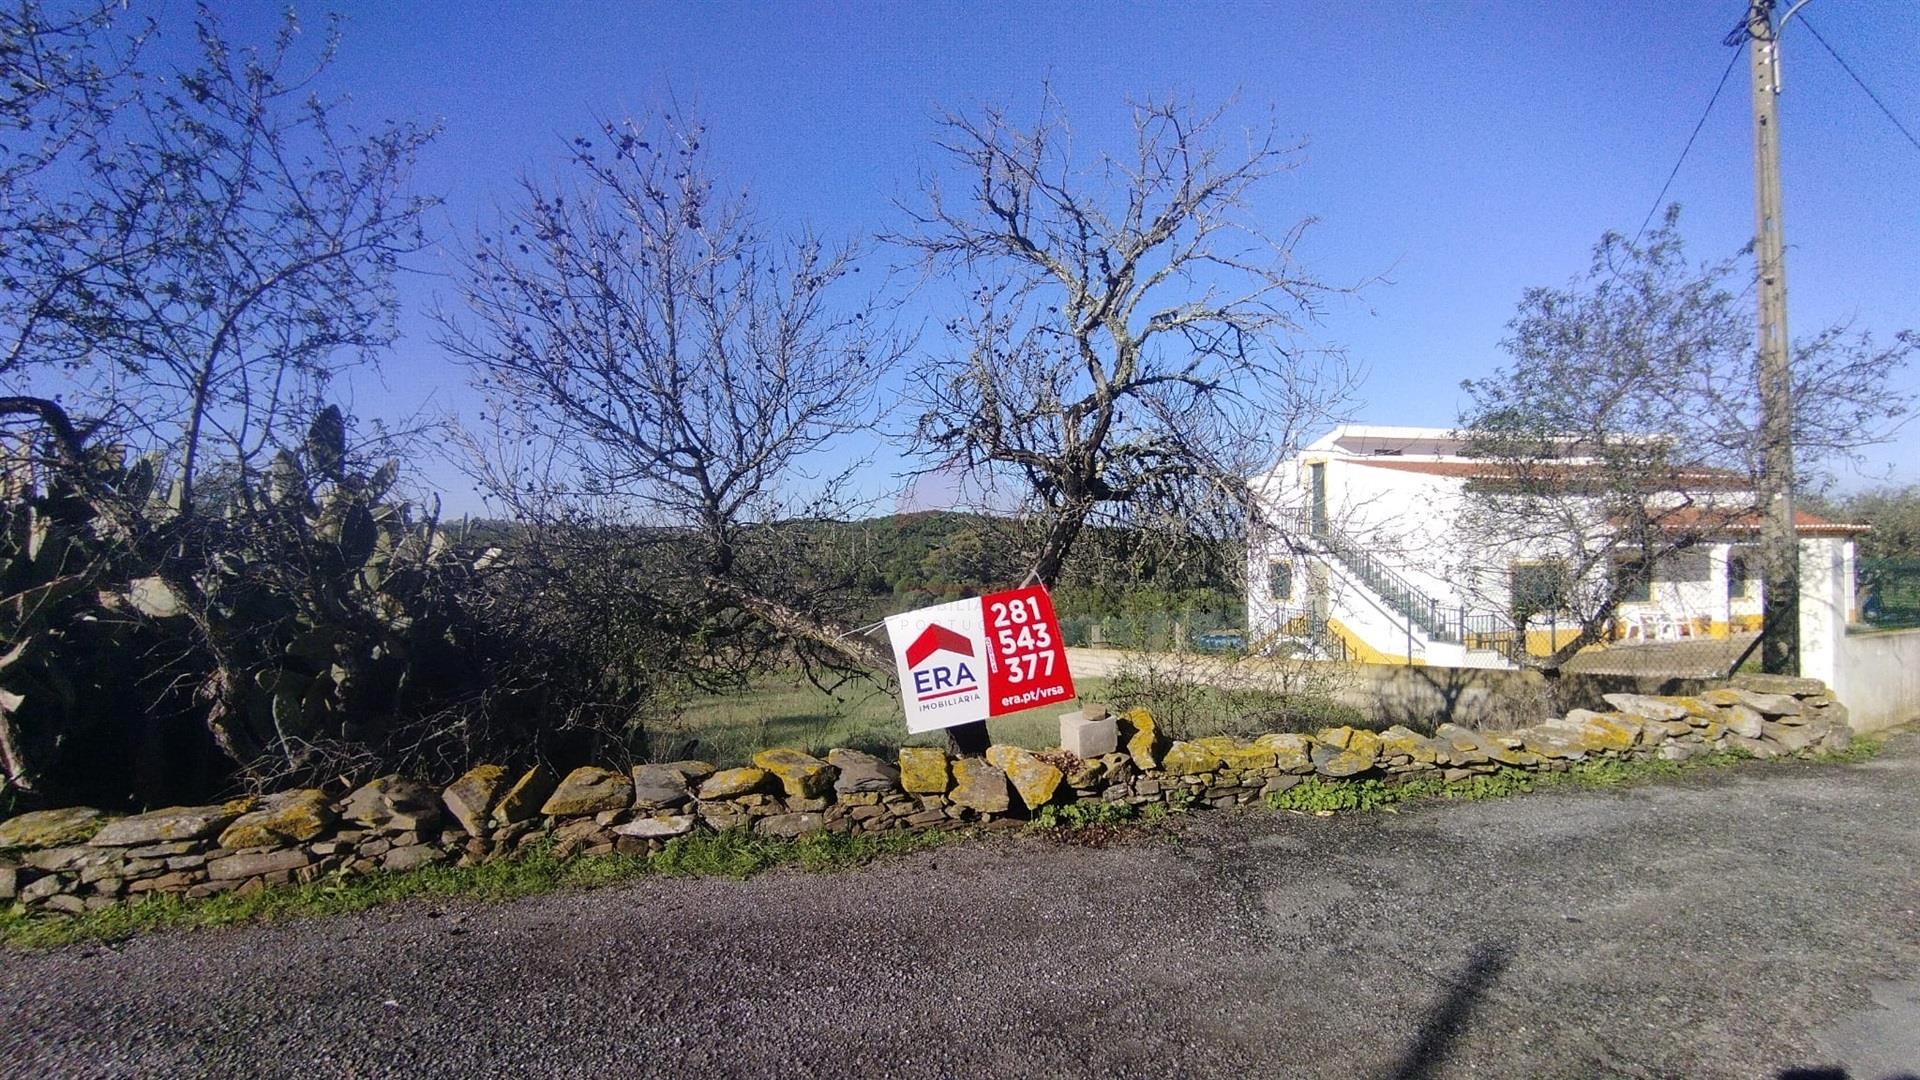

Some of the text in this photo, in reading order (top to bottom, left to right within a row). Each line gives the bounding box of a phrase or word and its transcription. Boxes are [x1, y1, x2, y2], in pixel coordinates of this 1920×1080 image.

[990, 596, 1041, 628] 281
[998, 622, 1051, 655] 543
[913, 662, 976, 694] ERA
[1004, 649, 1055, 684] 377
[1001, 685, 1065, 706] era.pt/vrsa
